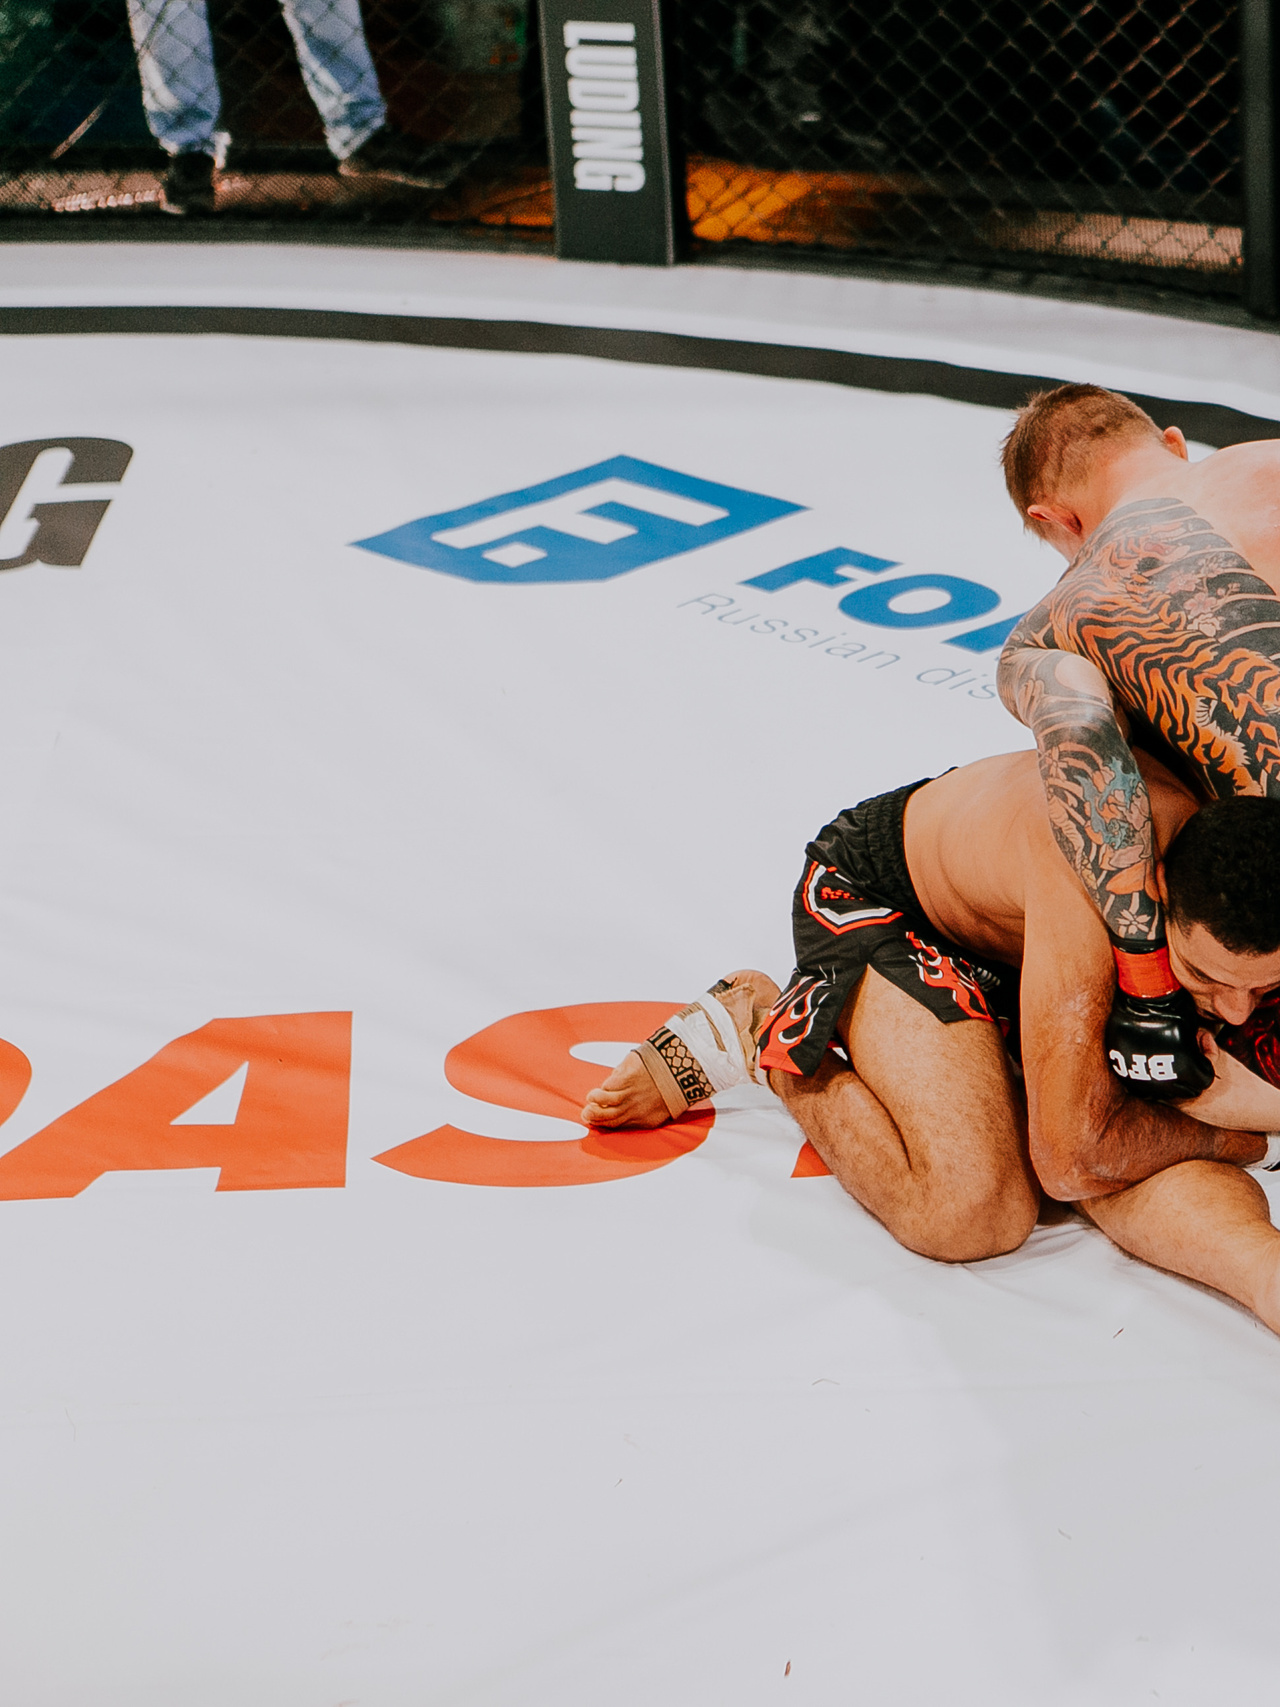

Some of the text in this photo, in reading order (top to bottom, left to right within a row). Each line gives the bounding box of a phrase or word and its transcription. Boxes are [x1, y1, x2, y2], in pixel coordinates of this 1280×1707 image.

[563, 20, 646, 192] LUDING
[676, 593, 1001, 700] Russian dis
[736, 546, 1034, 654] FO
[1108, 1048, 1178, 1082] BFC
